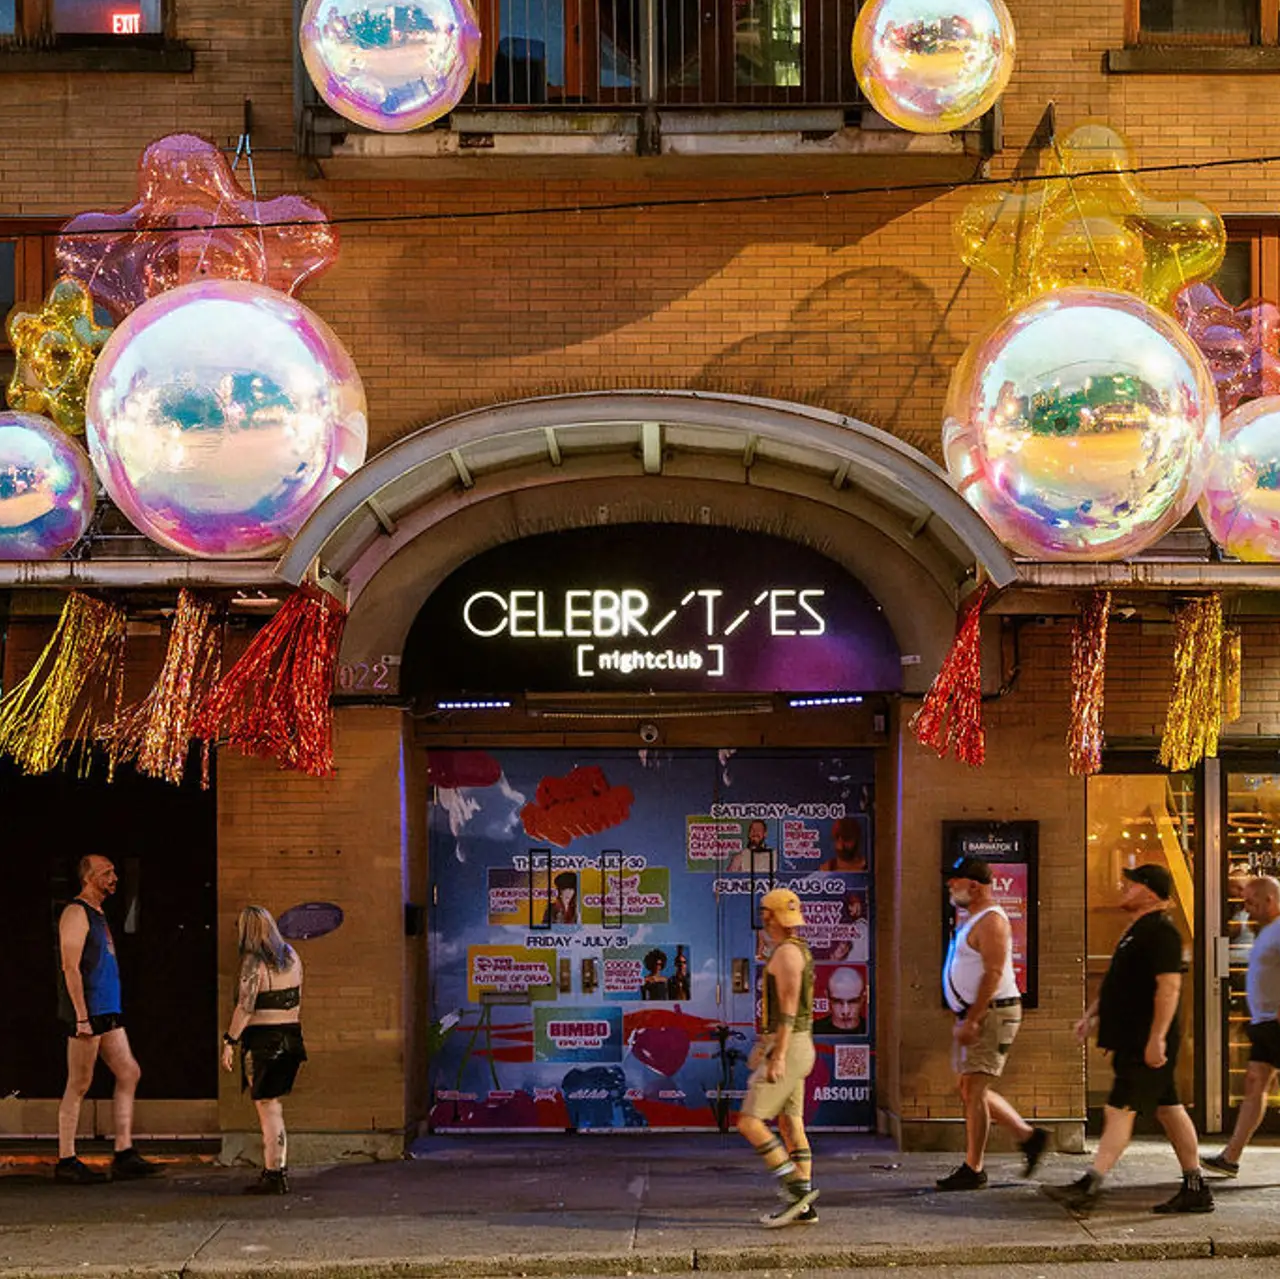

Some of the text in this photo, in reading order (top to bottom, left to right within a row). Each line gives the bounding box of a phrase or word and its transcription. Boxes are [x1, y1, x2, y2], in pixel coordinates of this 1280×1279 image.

[113, 14, 140, 34] EXIT
[712, 804, 787, 818] SATURDAY
[797, 804, 828, 818] AUG
[513, 856, 586, 870] THURSDAY
[596, 856, 627, 870] JULY
[714, 879, 776, 894] SUNDAY
[789, 879, 821, 894] AUG
[824, 879, 846, 894] 02
[526, 936, 571, 947] FRIDAY
[583, 936, 613, 947] JULY
[549, 1022, 608, 1037] BIMBO
[814, 1086, 870, 1101] ABSOLUT
